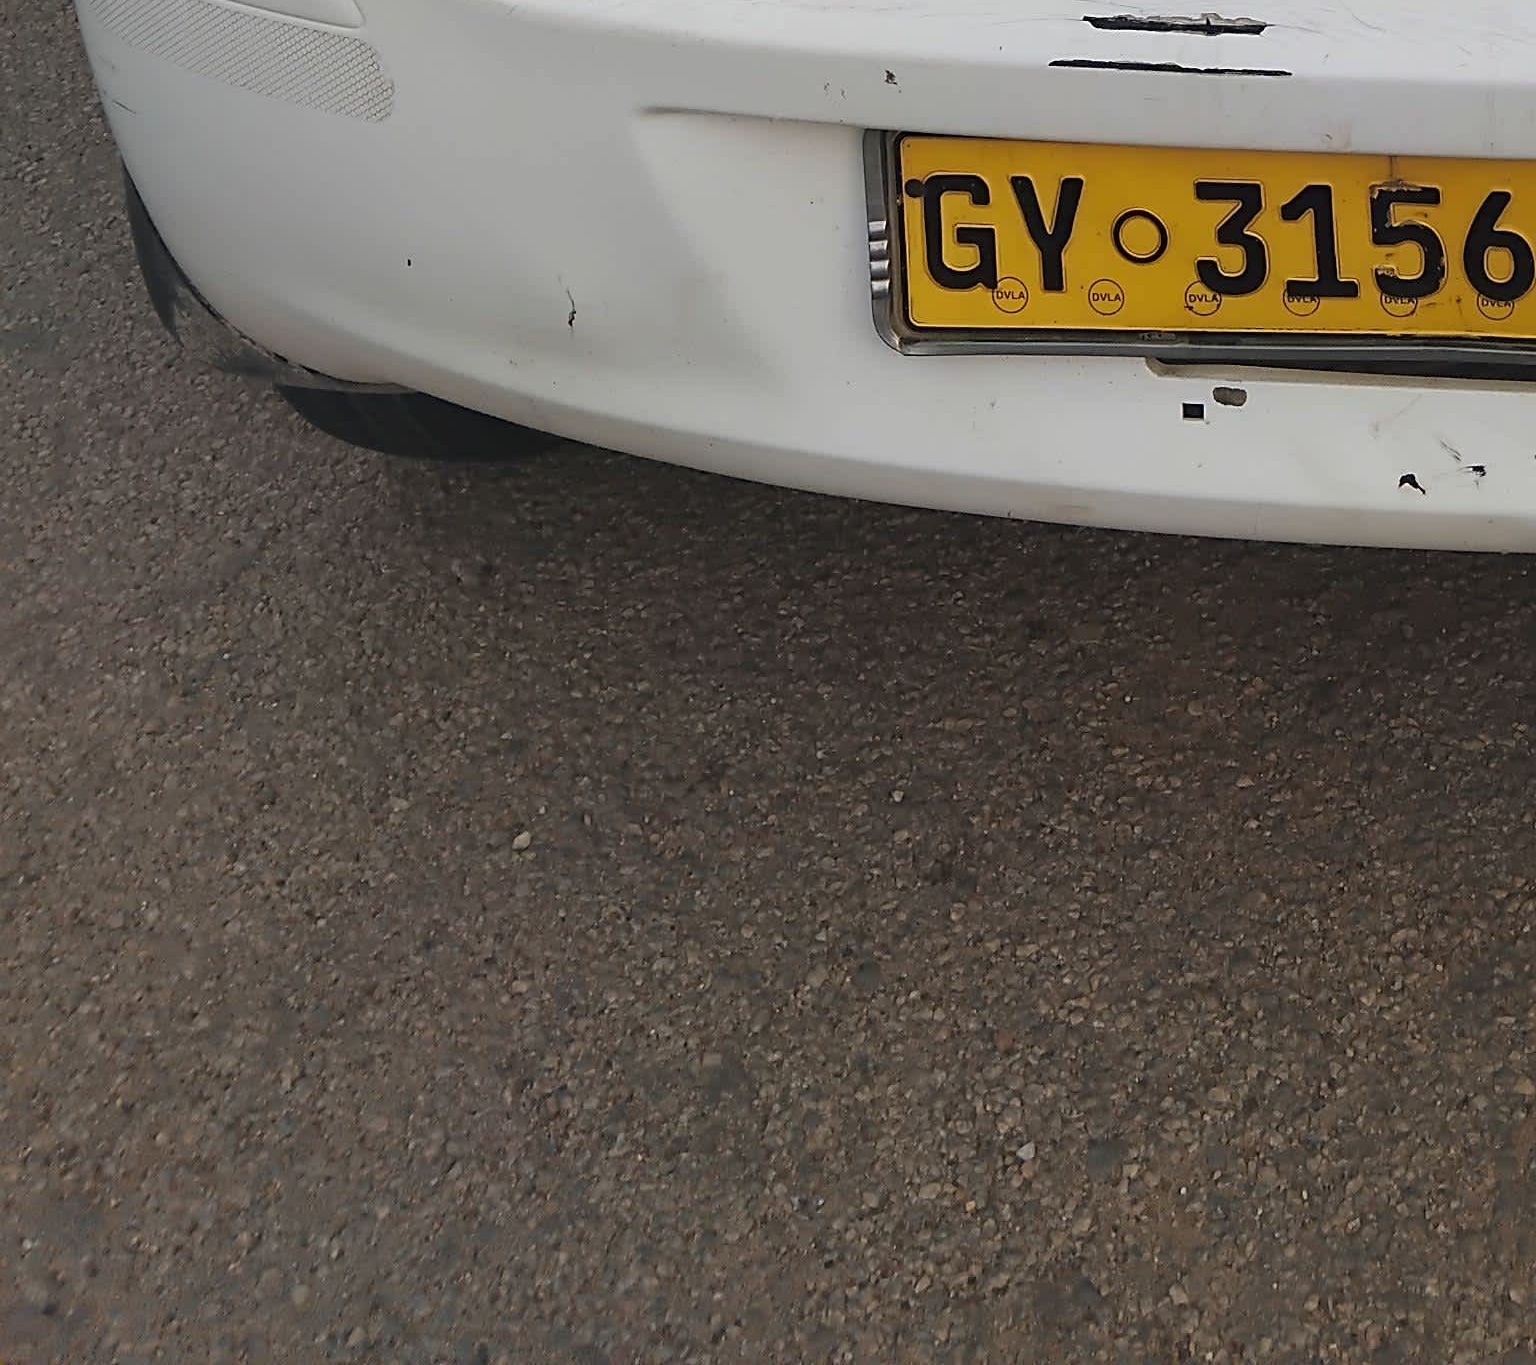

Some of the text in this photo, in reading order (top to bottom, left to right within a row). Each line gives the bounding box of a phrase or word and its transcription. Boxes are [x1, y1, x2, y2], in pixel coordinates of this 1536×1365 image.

[922, 173, 1085, 292] GY
[996, 291, 1025, 301] DVLA
[1092, 292, 1121, 302] DVLA
[1189, 294, 1218, 303] DVLA
